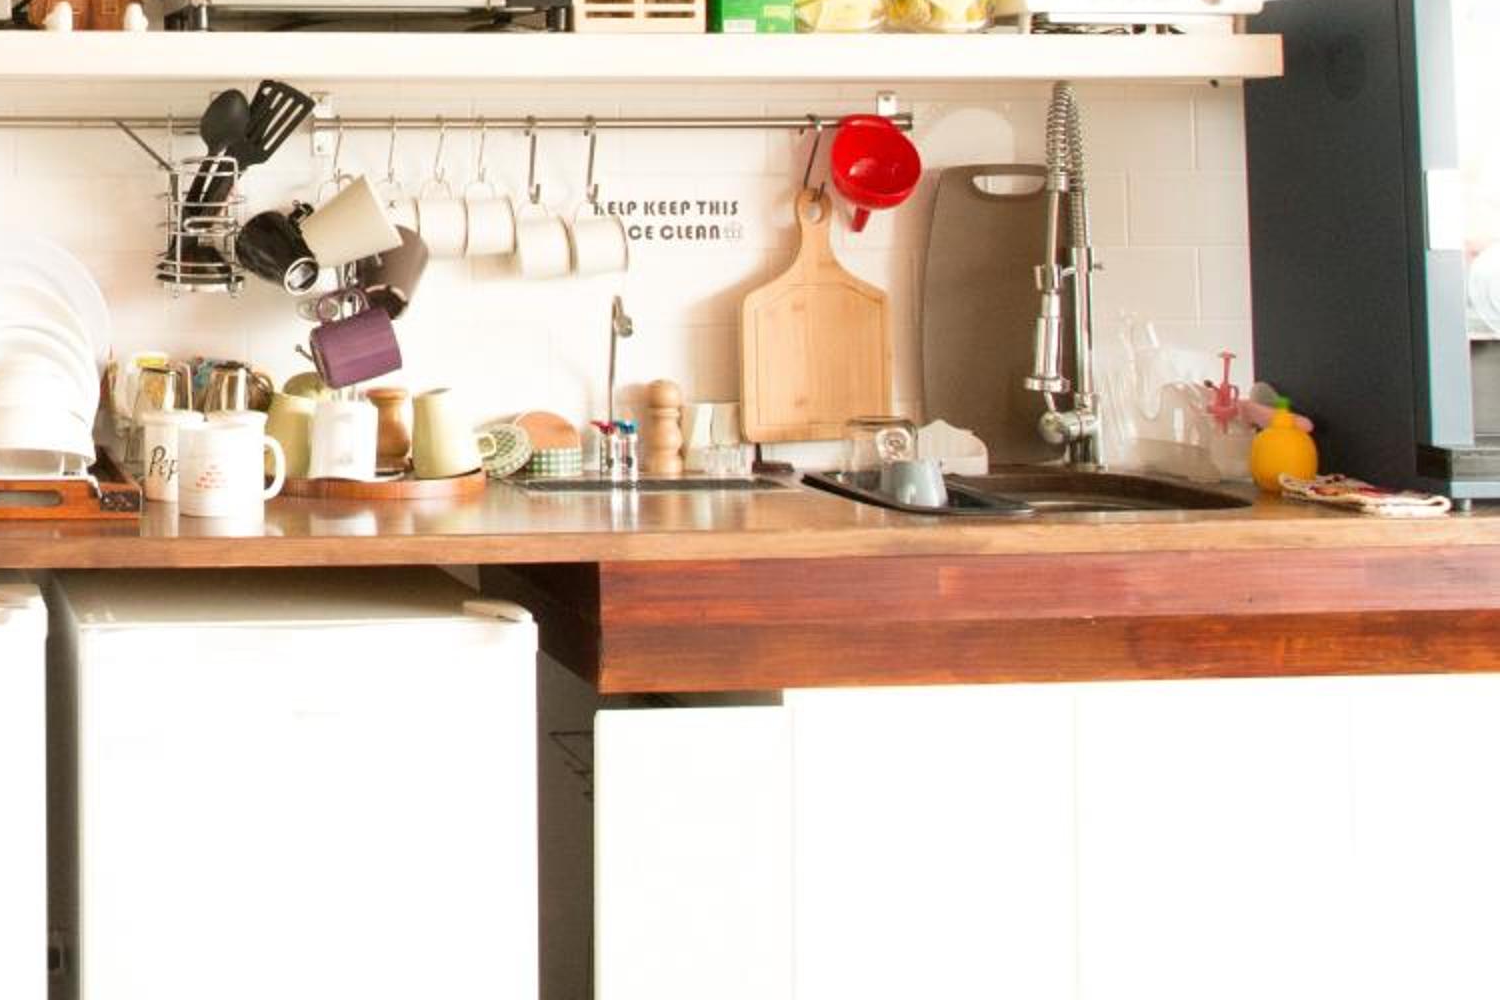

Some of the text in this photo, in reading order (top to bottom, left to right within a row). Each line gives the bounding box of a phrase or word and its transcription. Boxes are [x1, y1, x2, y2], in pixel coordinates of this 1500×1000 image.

[644, 200, 691, 216] KEEP
[696, 200, 739, 216] THIS
[660, 225, 721, 241] CLEAN
